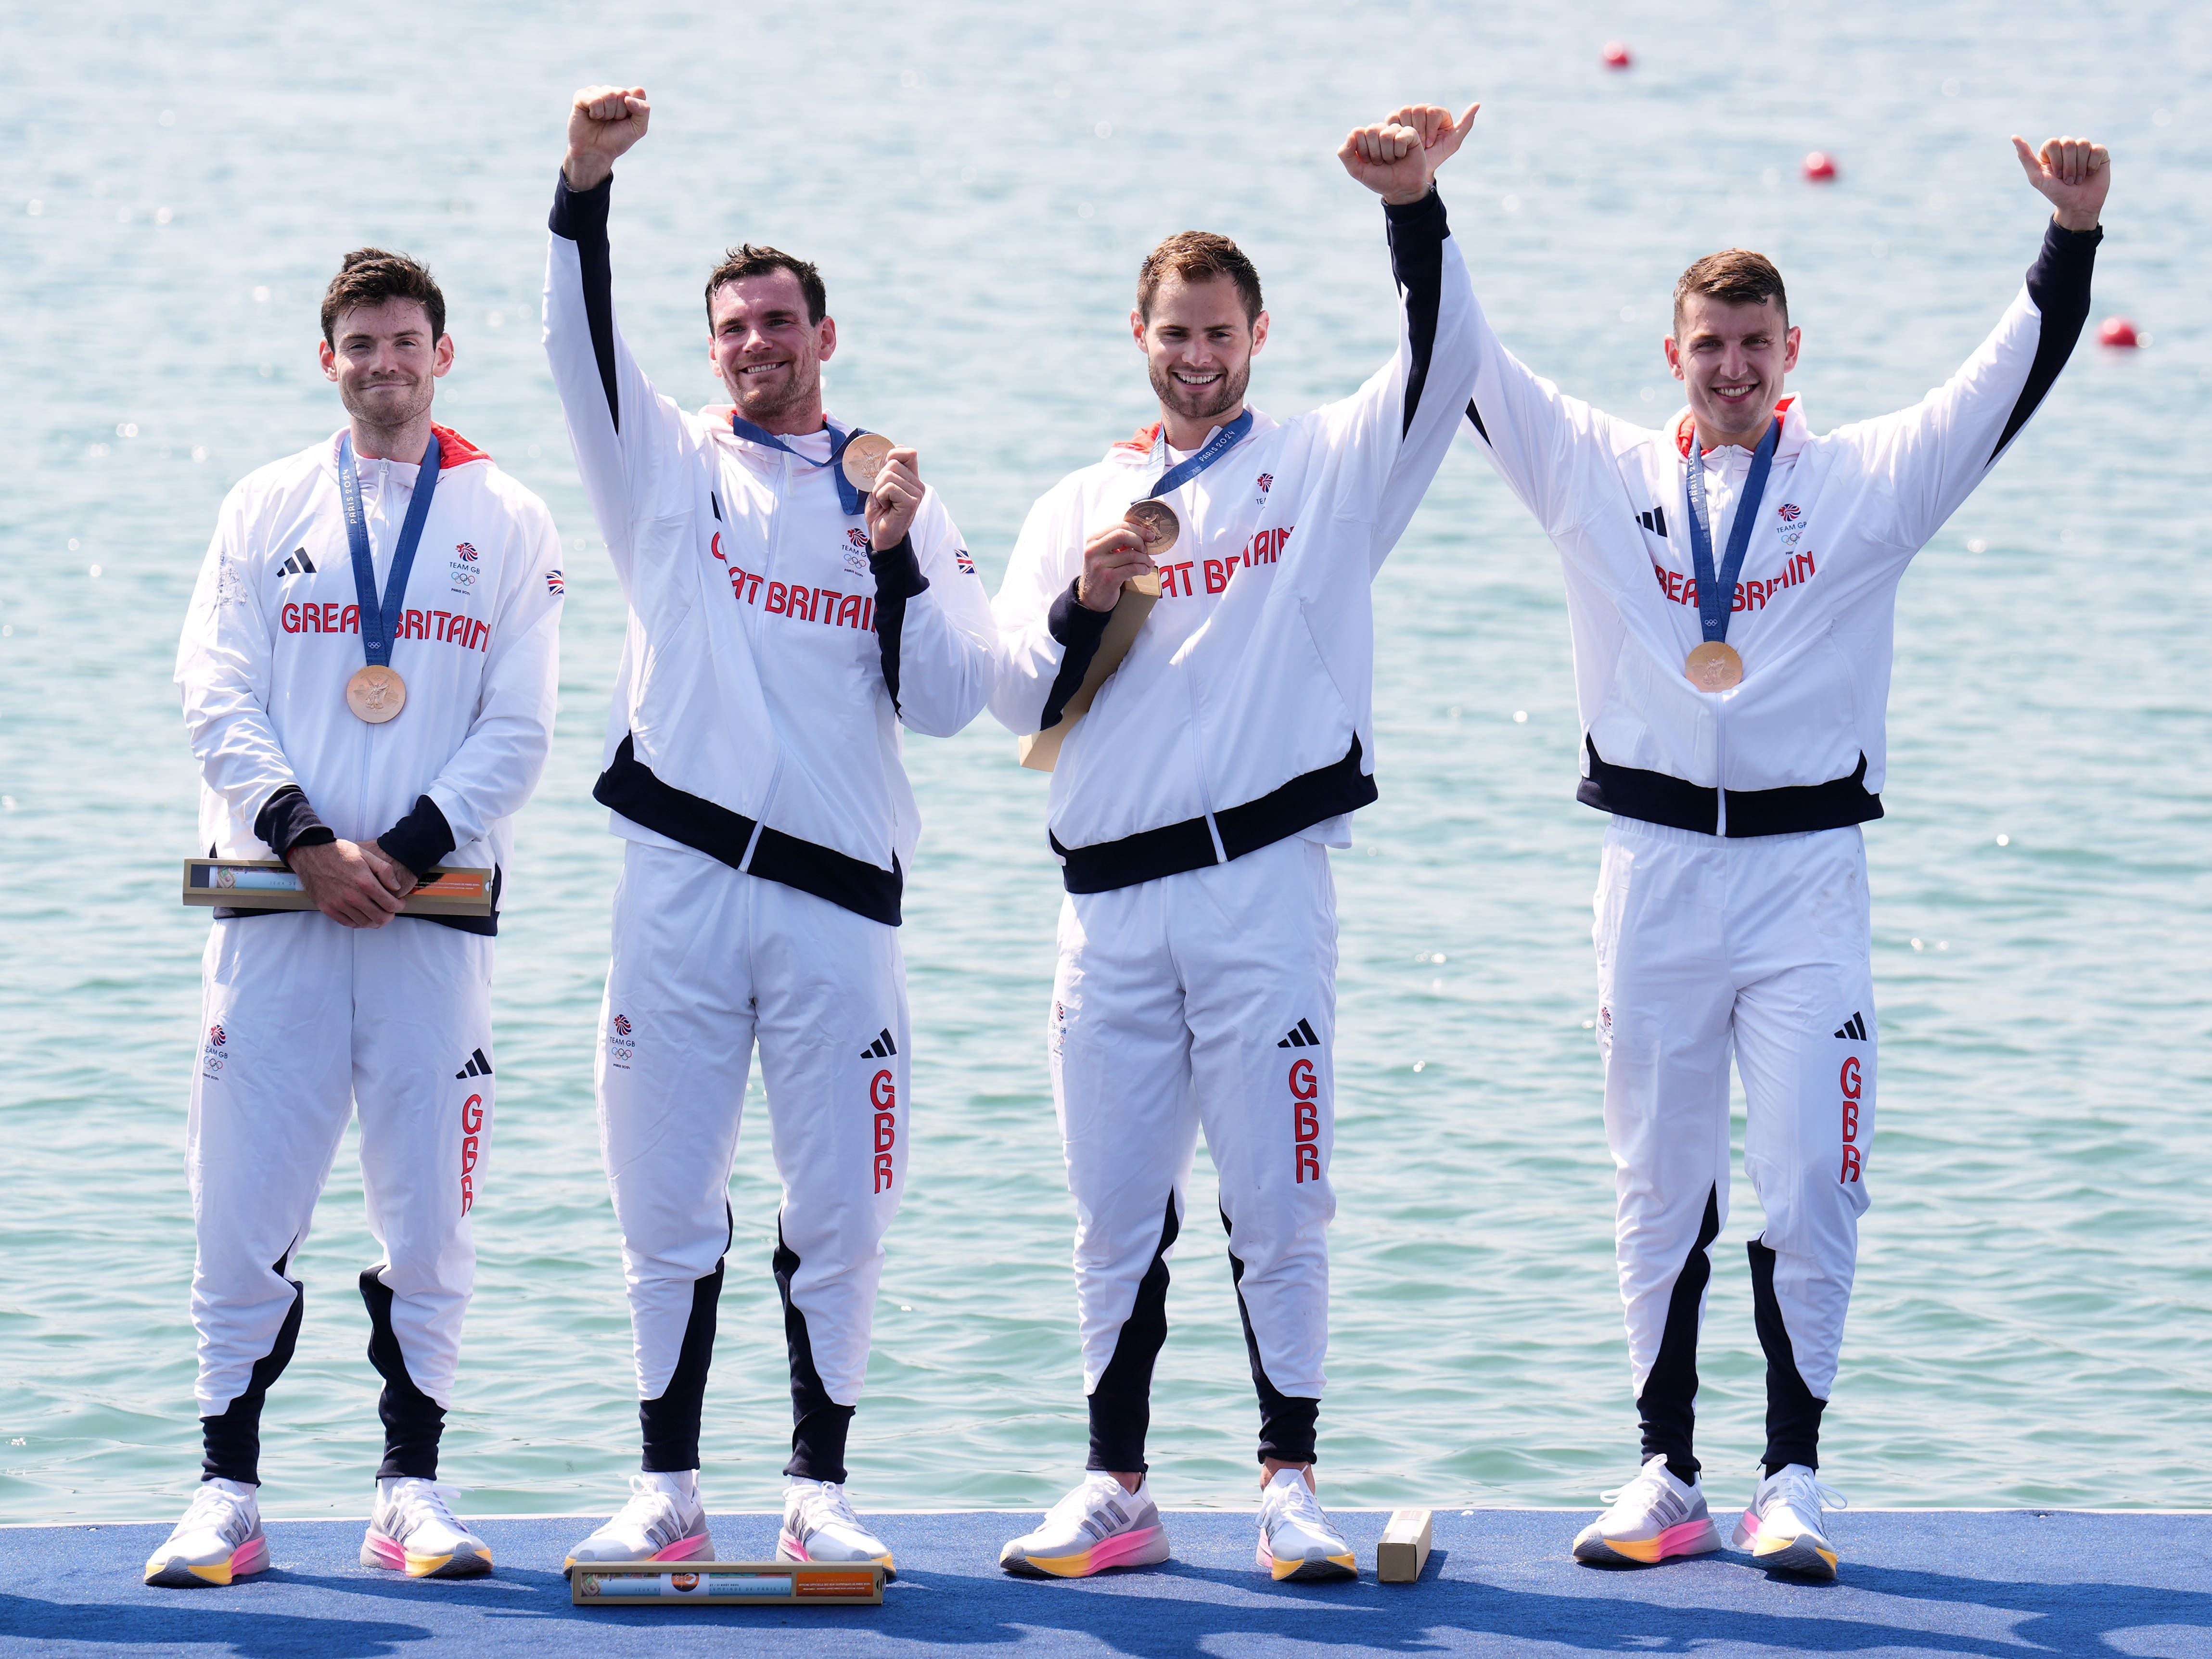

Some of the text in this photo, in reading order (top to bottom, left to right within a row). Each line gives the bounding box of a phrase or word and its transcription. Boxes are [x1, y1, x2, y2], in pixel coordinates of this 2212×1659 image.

[1216, 431, 1235, 447] 2024
[343, 469, 352, 494] 2024
[842, 545, 859, 555] TEAM
[1777, 524, 1796, 533] TEAM
[449, 562, 480, 574] TEAM GB
[711, 531, 877, 635] GAT BRITAI
[1203, 526, 1294, 594] BRAIN
[1655, 551, 1816, 613] REA BRIIN
[281, 603, 360, 634] GREA
[610, 1036, 625, 1046] TEAM
[869, 1069, 895, 1194] GBR
[1289, 1059, 1319, 1184] GBR
[1840, 1056, 1861, 1184] GBR
[461, 1094, 483, 1218] GBR
